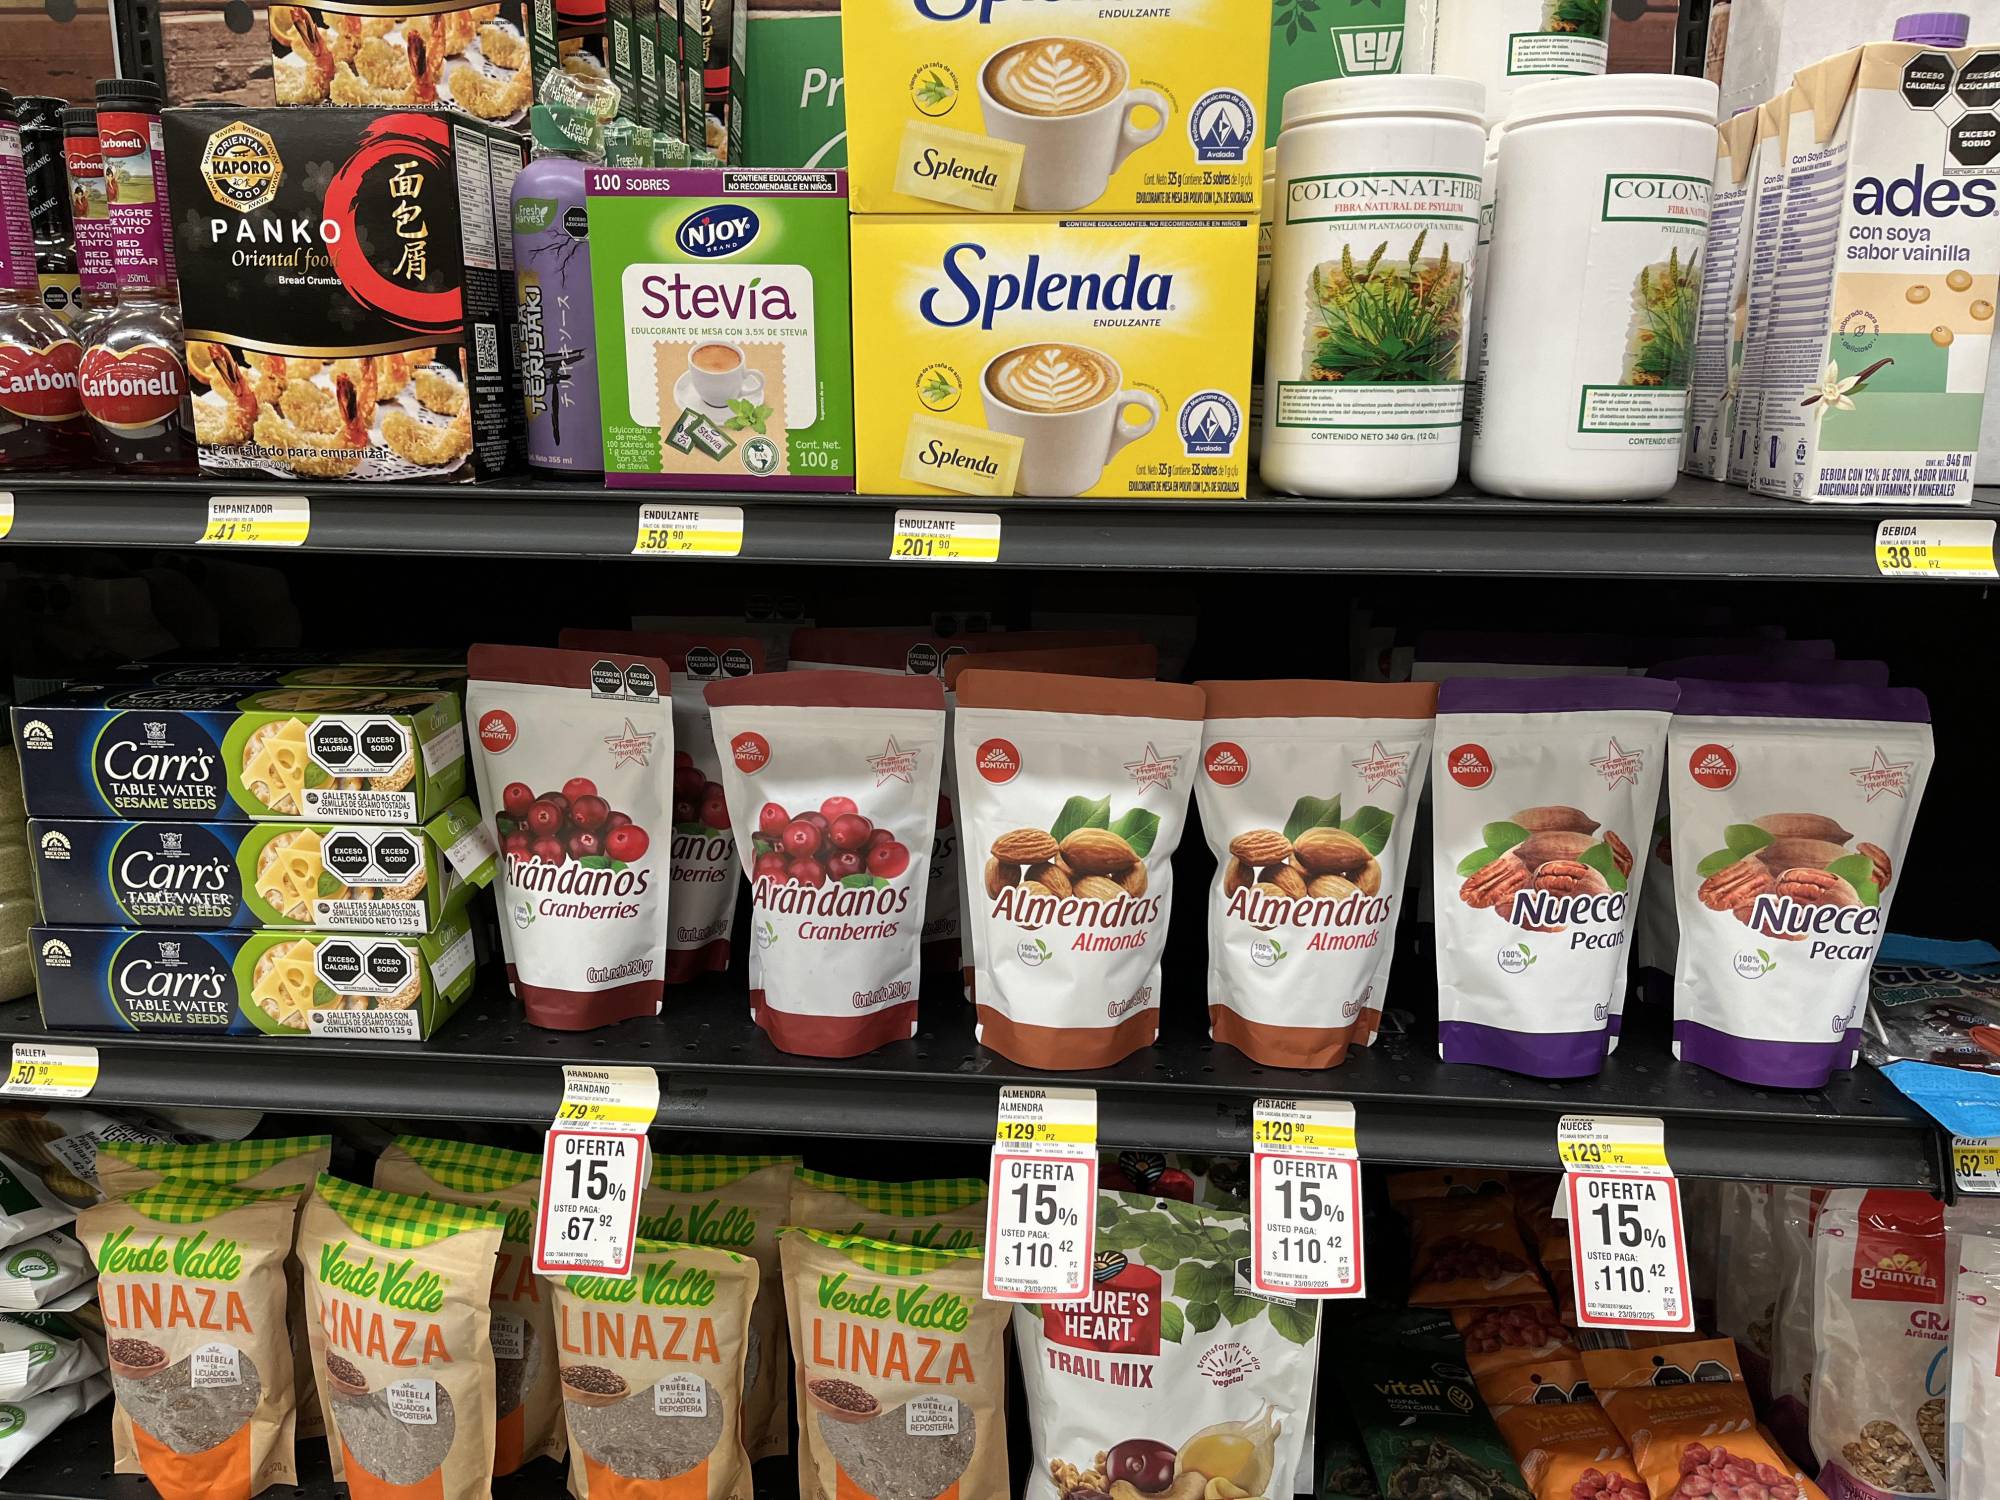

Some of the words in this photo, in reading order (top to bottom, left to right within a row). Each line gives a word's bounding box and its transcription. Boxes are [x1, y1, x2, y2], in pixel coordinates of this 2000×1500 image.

[1098, 8, 1171, 19] ENDULZANTE
[216, 136, 263, 157] ORIENTAL
[1961, 139, 1991, 148] SODIO
[212, 160, 271, 175] KAPORO
[913, 149, 999, 188] Splenda
[593, 175, 621, 191] 100
[626, 178, 670, 191] SOBRES
[732, 174, 768, 182] CONTIENE
[769, 174, 828, 183] EDULCORANTES,
[227, 187, 260, 199] FOOD
[740, 183, 799, 191] RECOMENDABLE
[810, 182, 832, 191] NIÑOS
[1853, 164, 1998, 218] ades
[1334, 203, 1361, 212] FIBRA
[1364, 202, 1412, 211] NATURAL
[1414, 202, 1426, 211] DE
[1428, 202, 1463, 212] PSYLLIUM
[112, 227, 145, 235] TINTO
[210, 218, 342, 244] PANKO
[1850, 225, 1883, 240] con
[1886, 227, 1930, 243] soya
[116, 239, 140, 247] RED
[115, 249, 144, 257] WINE
[1847, 243, 1900, 261] sabor
[1903, 244, 1970, 262] vainilla
[232, 248, 300, 267] Oriental
[298, 248, 341, 274] food
[278, 275, 306, 285] Bread
[307, 276, 342, 285] Crumbs
[919, 242, 1173, 331] Splenda
[518, 303, 533, 397] SALSA
[81, 371, 179, 397] Carbonell
[609, 427, 653, 435] Edulcorante
[212, 444, 236, 457] Pan
[238, 444, 284, 457] rallado
[287, 448, 319, 459] para
[320, 447, 388, 460] empanizar
[795, 441, 820, 450] Cont.
[822, 441, 841, 450] Net.
[918, 439, 998, 476] Splenda
[1946, 454, 1960, 468] 946
[1961, 454, 1972, 467] ml
[1818, 483, 1859, 497] ADICIONADA
[1860, 483, 1875, 497] CON
[1875, 483, 1912, 497] VITAMINAS
[1912, 484, 1918, 497] Y
[1918, 483, 1955, 497] MINERALES
[213, 503, 273, 515] EMPANIZADOR
[644, 510, 700, 521] ENDULZANTE
[899, 519, 956, 530] ENDULZANTE
[1882, 526, 1917, 537] BEBIDA
[939, 540, 950, 549] 90
[319, 736, 349, 745] EXCESO
[366, 736, 396, 745] EXCESO
[370, 743, 393, 752] SODIO
[317, 743, 353, 753] CALORÍAS
[105, 740, 215, 781] Carr's
[980, 760, 1016, 770] BONTATTI
[1208, 763, 1244, 772] BONTATTI
[110, 783, 158, 797] TABLE
[159, 783, 217, 797] WATER
[322, 792, 357, 801] GALLETAS
[358, 793, 390, 802] SALADAS
[391, 794, 406, 802] CON
[114, 796, 169, 809] SESAME
[172, 797, 217, 810] SEEDS
[317, 807, 364, 817] CONTENIDO
[364, 808, 386, 817] NETO
[388, 809, 402, 818] 125
[403, 811, 409, 820] g
[121, 851, 229, 890] Carr's
[506, 853, 650, 897] Arándanos
[753, 878, 909, 917] Arándanos
[131, 905, 184, 917] SESAME
[189, 905, 232, 918] SEEDS
[539, 899, 639, 920] Cranberries
[992, 889, 1162, 930] Almendras
[1227, 886, 1393, 930] Almendras
[798, 921, 899, 942] Cranberries
[1071, 929, 1147, 952] Almonds
[1306, 930, 1379, 952] Almonds
[1502, 950, 1522, 959] 100%
[120, 959, 226, 999] Carr's
[126, 998, 171, 1012] TABLE
[172, 999, 229, 1014] WATER
[15, 1048, 46, 1057] GALLETA
[567, 1070, 609, 1080] ARANDANO
[568, 1083, 610, 1095] ARANDANO
[1002, 1089, 1047, 1099] ALMENDRA
[1000, 1102, 1043, 1113] ALMENDRA
[1257, 1099, 1297, 1110] PISTACHE
[1560, 1121, 1592, 1131] NUECES
[1295, 1123, 1305, 1132] 90
[1304, 1135, 1314, 1144] PZ
[1955, 1138, 1987, 1146] PALETA
[1011, 1162, 1074, 1182] OFERTA
[1273, 1159, 1338, 1180] OFERTA
[565, 1158, 626, 1202] 15%
[1588, 1181, 1656, 1201] OFERTA
[1011, 1182, 1078, 1227] 15%
[1274, 1179, 1345, 1223] 15%
[554, 1204, 578, 1213] USTED
[579, 1205, 601, 1214] PAGA:
[600, 1214, 613, 1227] 92
[1592, 1202, 1666, 1249] 15%
[1001, 1228, 1026, 1238] USTED
[1027, 1230, 1050, 1239] PAGA:
[99, 1225, 168, 1275] Verde
[172, 1230, 242, 1281] Valle
[319, 1240, 378, 1298] Verde
[378, 1258, 443, 1313] Valle
[1649, 1264, 1665, 1277] 42
[641, 1259, 716, 1307] Valle
[1293, 1279, 1329, 1288] 23/09/2025
[1859, 1267, 1937, 1289] granvita
[817, 1272, 892, 1319] Verde
[896, 1284, 970, 1333] Valle
[562, 1304, 721, 1364] LINAZA
[1065, 1315, 1133, 1341] HEART
[812, 1318, 976, 1385] LINAZA
[195, 1355, 233, 1365] PRUÉBELA
[1047, 1348, 1105, 1382] TRAIL
[1110, 1362, 1153, 1388] MIX
[1215, 1366, 1241, 1378] origen
[1212, 1374, 1244, 1388] vegetal
[1374, 1379, 1442, 1396] vitali
[659, 1397, 696, 1405] LICUADOS
[659, 1404, 703, 1414] REPOSTERÍA
